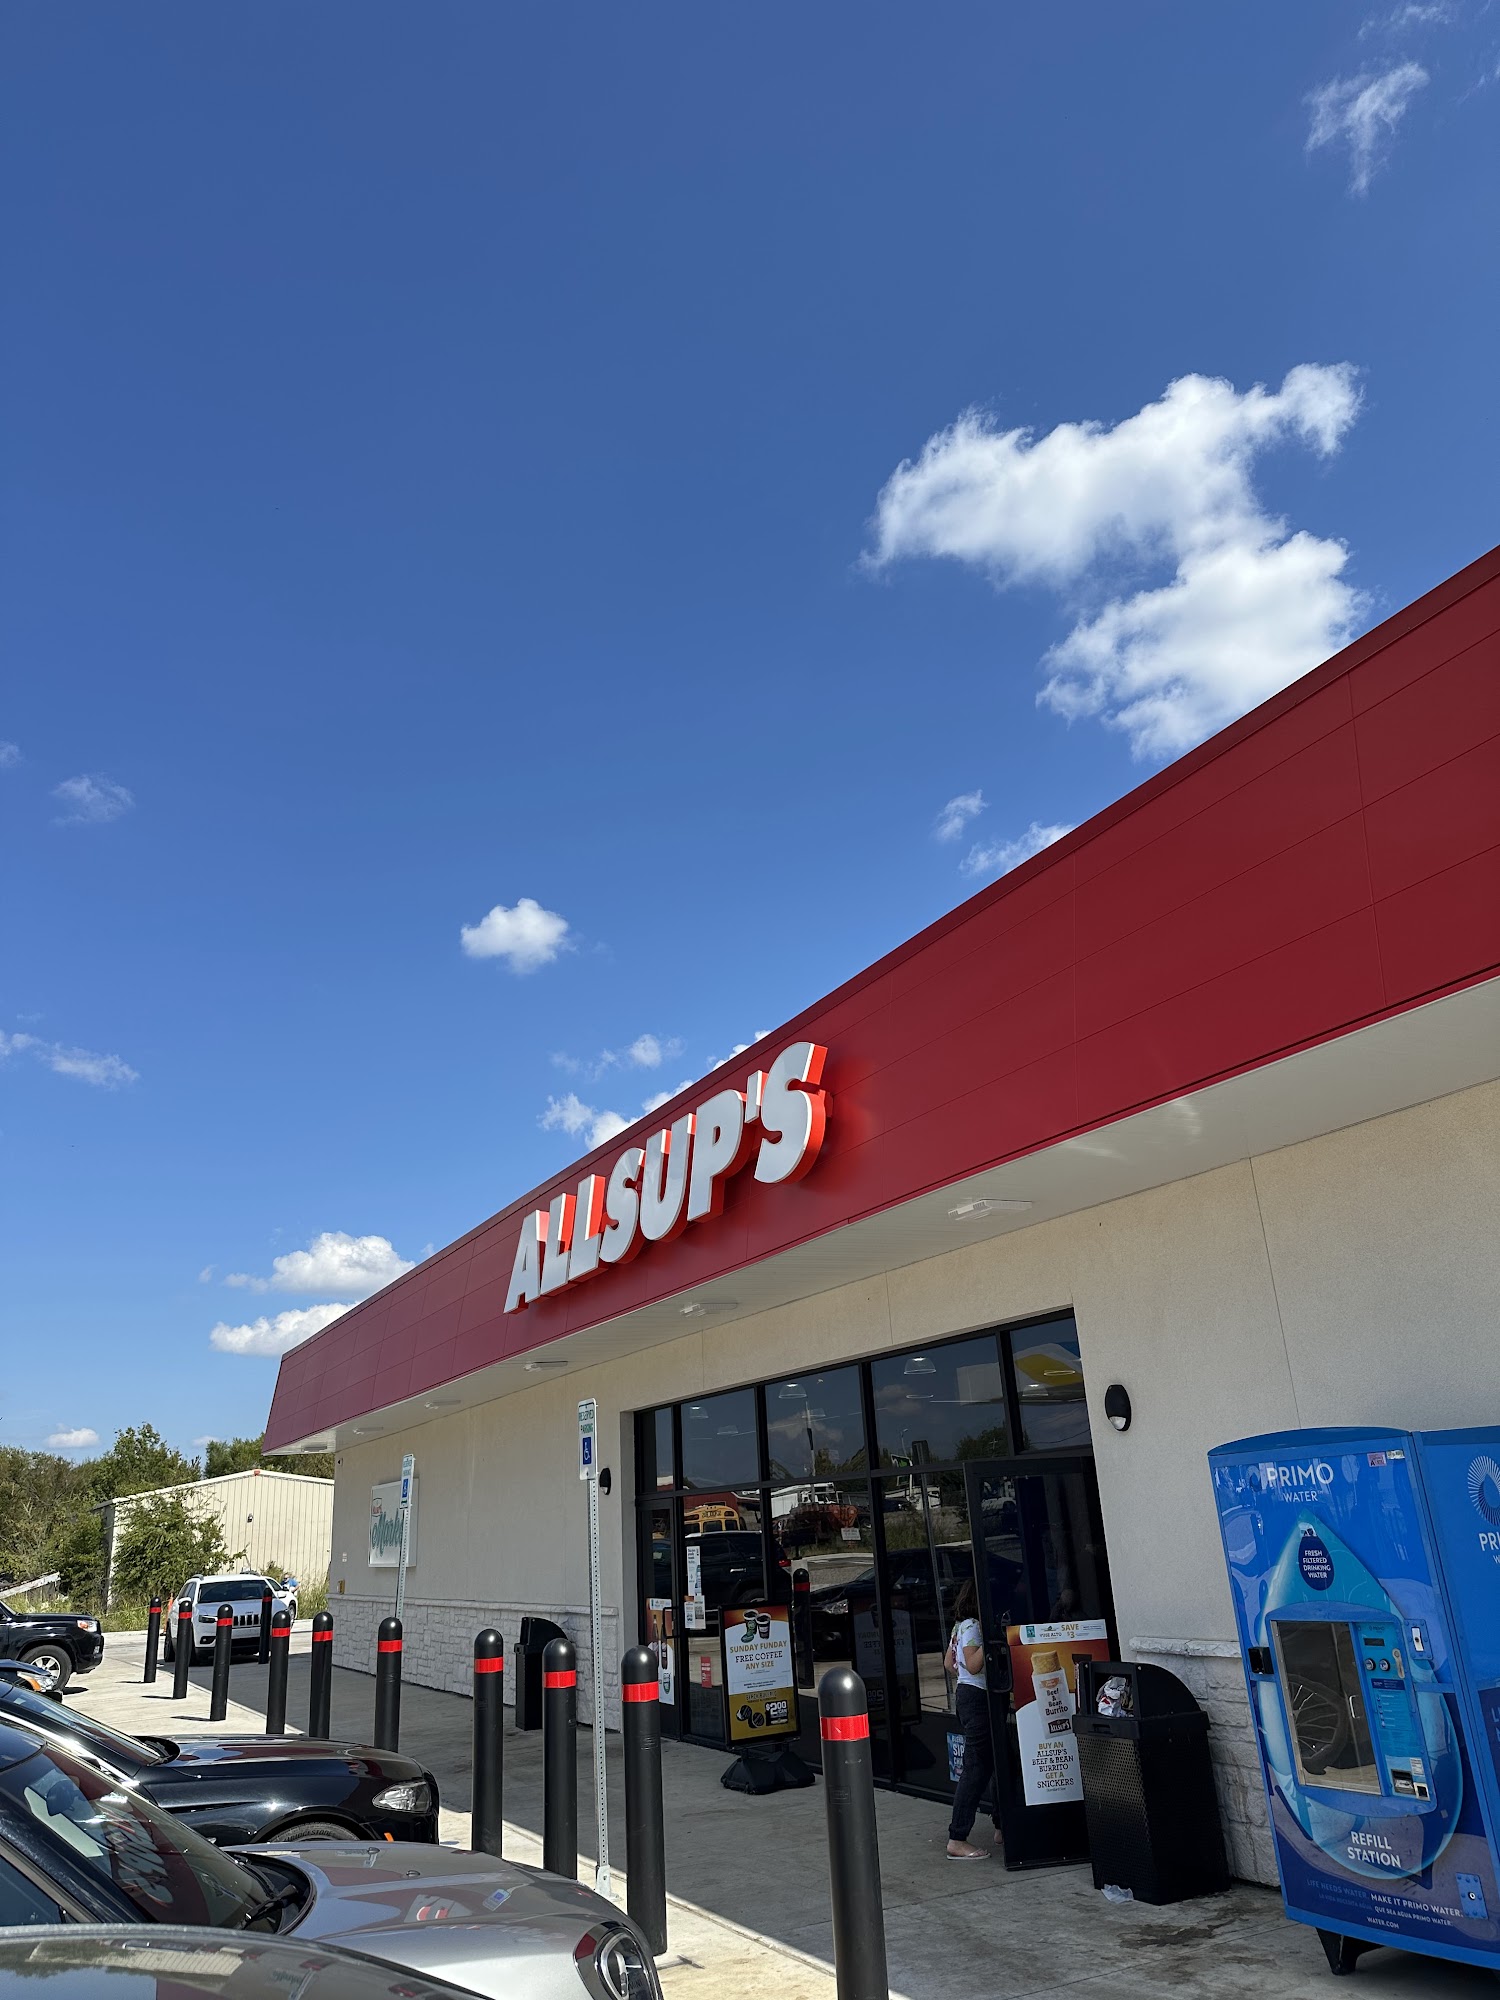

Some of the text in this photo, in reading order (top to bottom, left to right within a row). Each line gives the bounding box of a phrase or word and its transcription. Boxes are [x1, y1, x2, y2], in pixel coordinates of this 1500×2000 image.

[503, 1041, 825, 1314] ALLSUP'S
[1266, 1462, 1334, 1488] PRIMO
[1479, 1532, 1500, 1551] PRI
[1304, 1549, 1323, 1557] FRESH
[1307, 1571, 1328, 1579] WATER
[1060, 1623, 1080, 1632] SAVE
[1067, 1631, 1075, 1639] $3
[729, 1640, 788, 1654] SUNDAY FUNDAY
[735, 1650, 783, 1663] FREE COFFEE
[745, 1660, 775, 1670] ANY SIZE
[1045, 1705, 1069, 1716] Burrito
[1038, 1741, 1064, 1750] BUY AN
[1036, 1748, 1068, 1758] ALLSUP'S
[1031, 1757, 1048, 1766] BEEF
[1055, 1755, 1074, 1764] BEAN
[1038, 1763, 1069, 1773] BURRITO
[1045, 1772, 1058, 1780] GET
[1036, 1777, 1075, 1789] SNICKERS
[1350, 1830, 1392, 1850] REFILL
[1347, 1846, 1402, 1868] STATION
[1306, 1878, 1320, 1889] LIFE
[1320, 1882, 1343, 1894] NEEDS
[1370, 1893, 1393, 1905] MAKE
[1393, 1897, 1401, 1906] IT
[1402, 1899, 1430, 1912] PRIMO
[1430, 1904, 1464, 1918] WATER.
[1374, 1906, 1386, 1914] QUE
[1386, 1907, 1397, 1916] SEA
[1397, 1909, 1412, 1919] AGUA
[1412, 1912, 1431, 1923] PRIMO
[1366, 1915, 1400, 1930] WATER.COM
